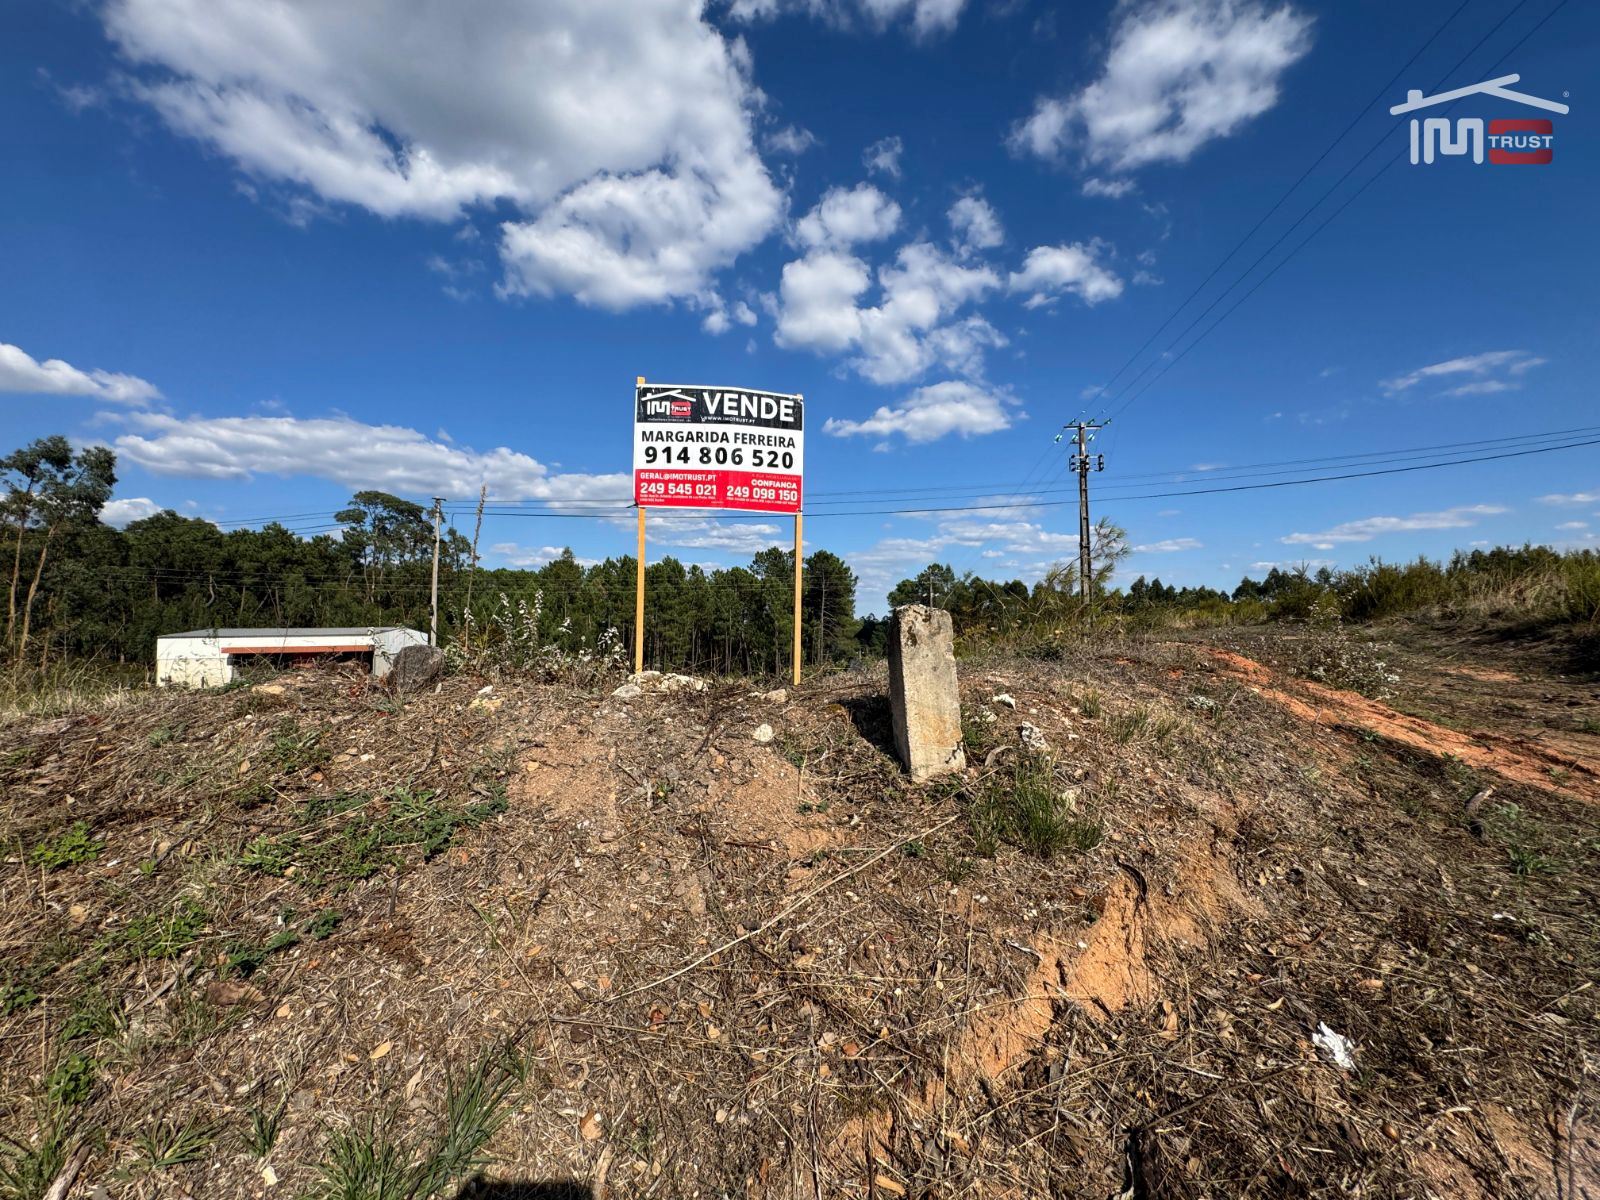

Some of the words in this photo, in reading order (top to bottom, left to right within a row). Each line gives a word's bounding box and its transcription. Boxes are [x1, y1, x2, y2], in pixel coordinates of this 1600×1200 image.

[702, 392, 795, 422] VENDE
[641, 430, 730, 443] MARGARIDA
[733, 432, 796, 448] FERREIRA
[645, 446, 690, 464] 914
[699, 447, 743, 465] 806
[752, 449, 794, 469] 520
[640, 472, 717, 482] GERAL@IMOTRUST.PT
[640, 483, 664, 494] 249
[667, 483, 692, 495] 545
[695, 484, 717, 496] 021
[726, 485, 750, 498] 249
[752, 487, 775, 500] 098
[778, 489, 798, 502] 150
